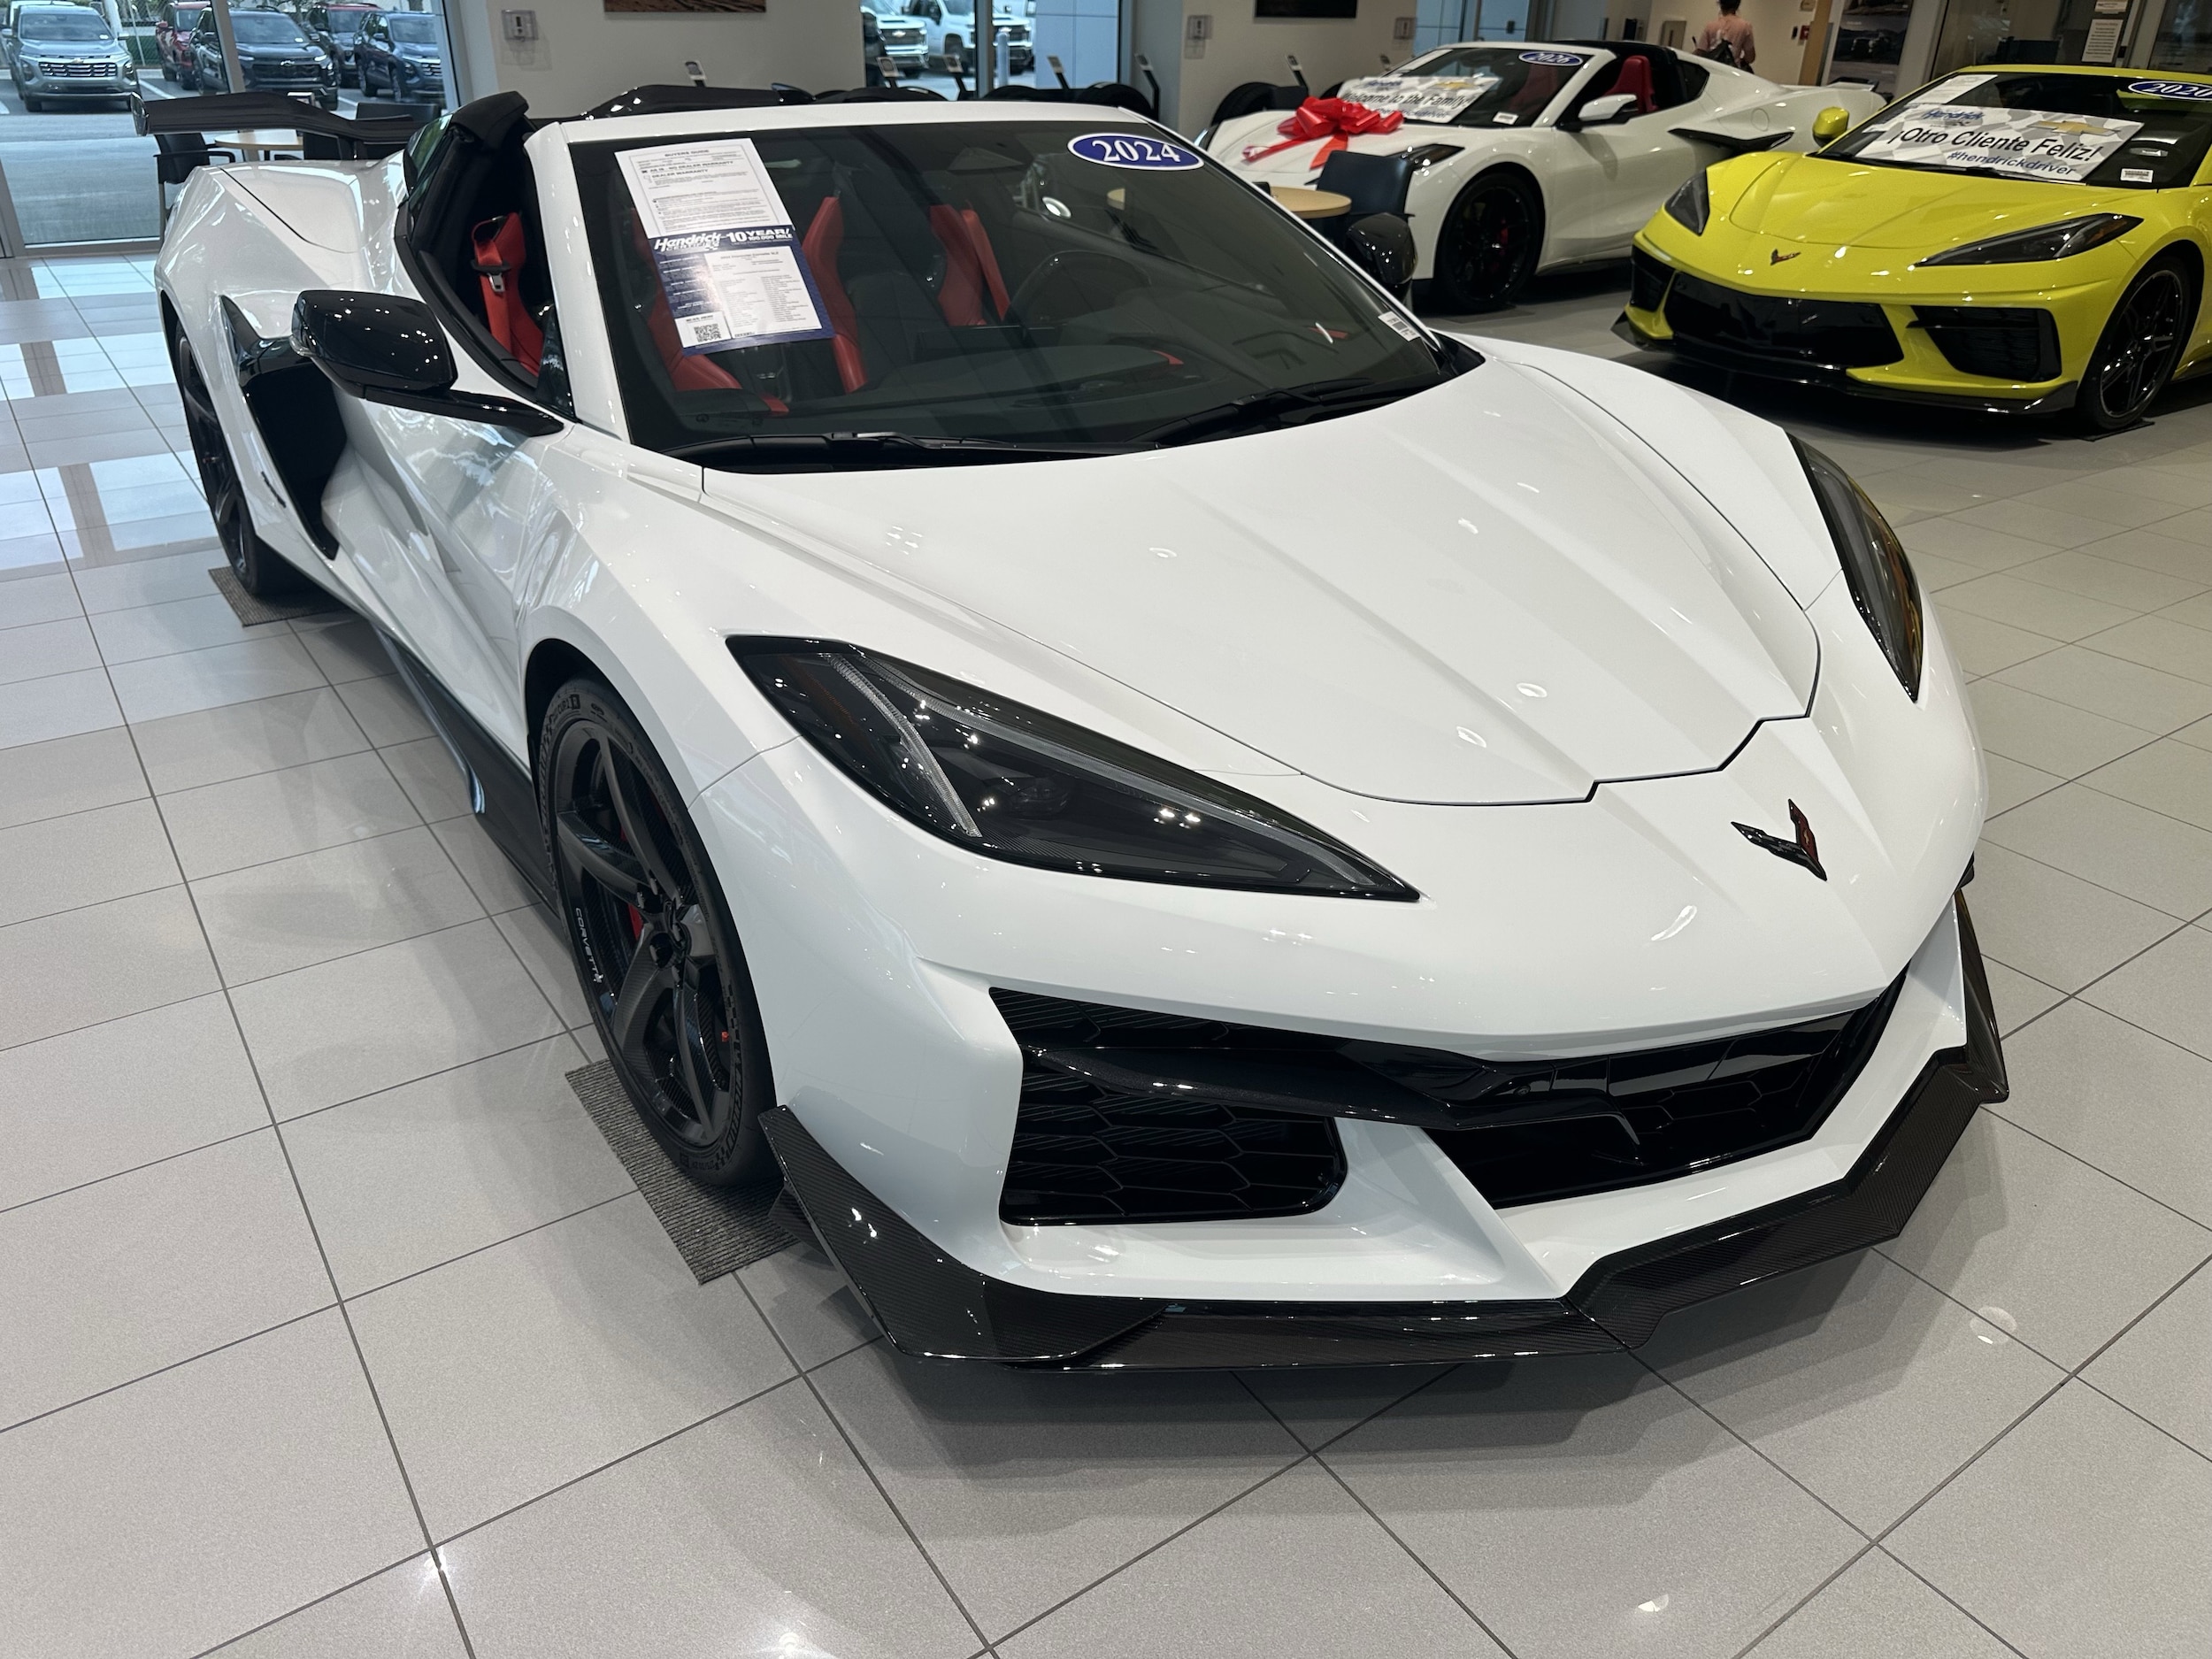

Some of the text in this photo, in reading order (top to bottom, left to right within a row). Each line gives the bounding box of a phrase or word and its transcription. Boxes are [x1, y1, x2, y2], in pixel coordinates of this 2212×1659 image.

[1403, 93, 1425, 105] the
[2141, 83, 2212, 97] 2020
[1091, 139, 1181, 163] 2024
[1887, 127, 2104, 162] ¡Otro Cliente Feliz!
[1946, 150, 2078, 176] #hendrickdriver
[654, 231, 722, 252] Hendrick
[726, 231, 748, 243] 10
[575, 907, 604, 983] CORVETTE
